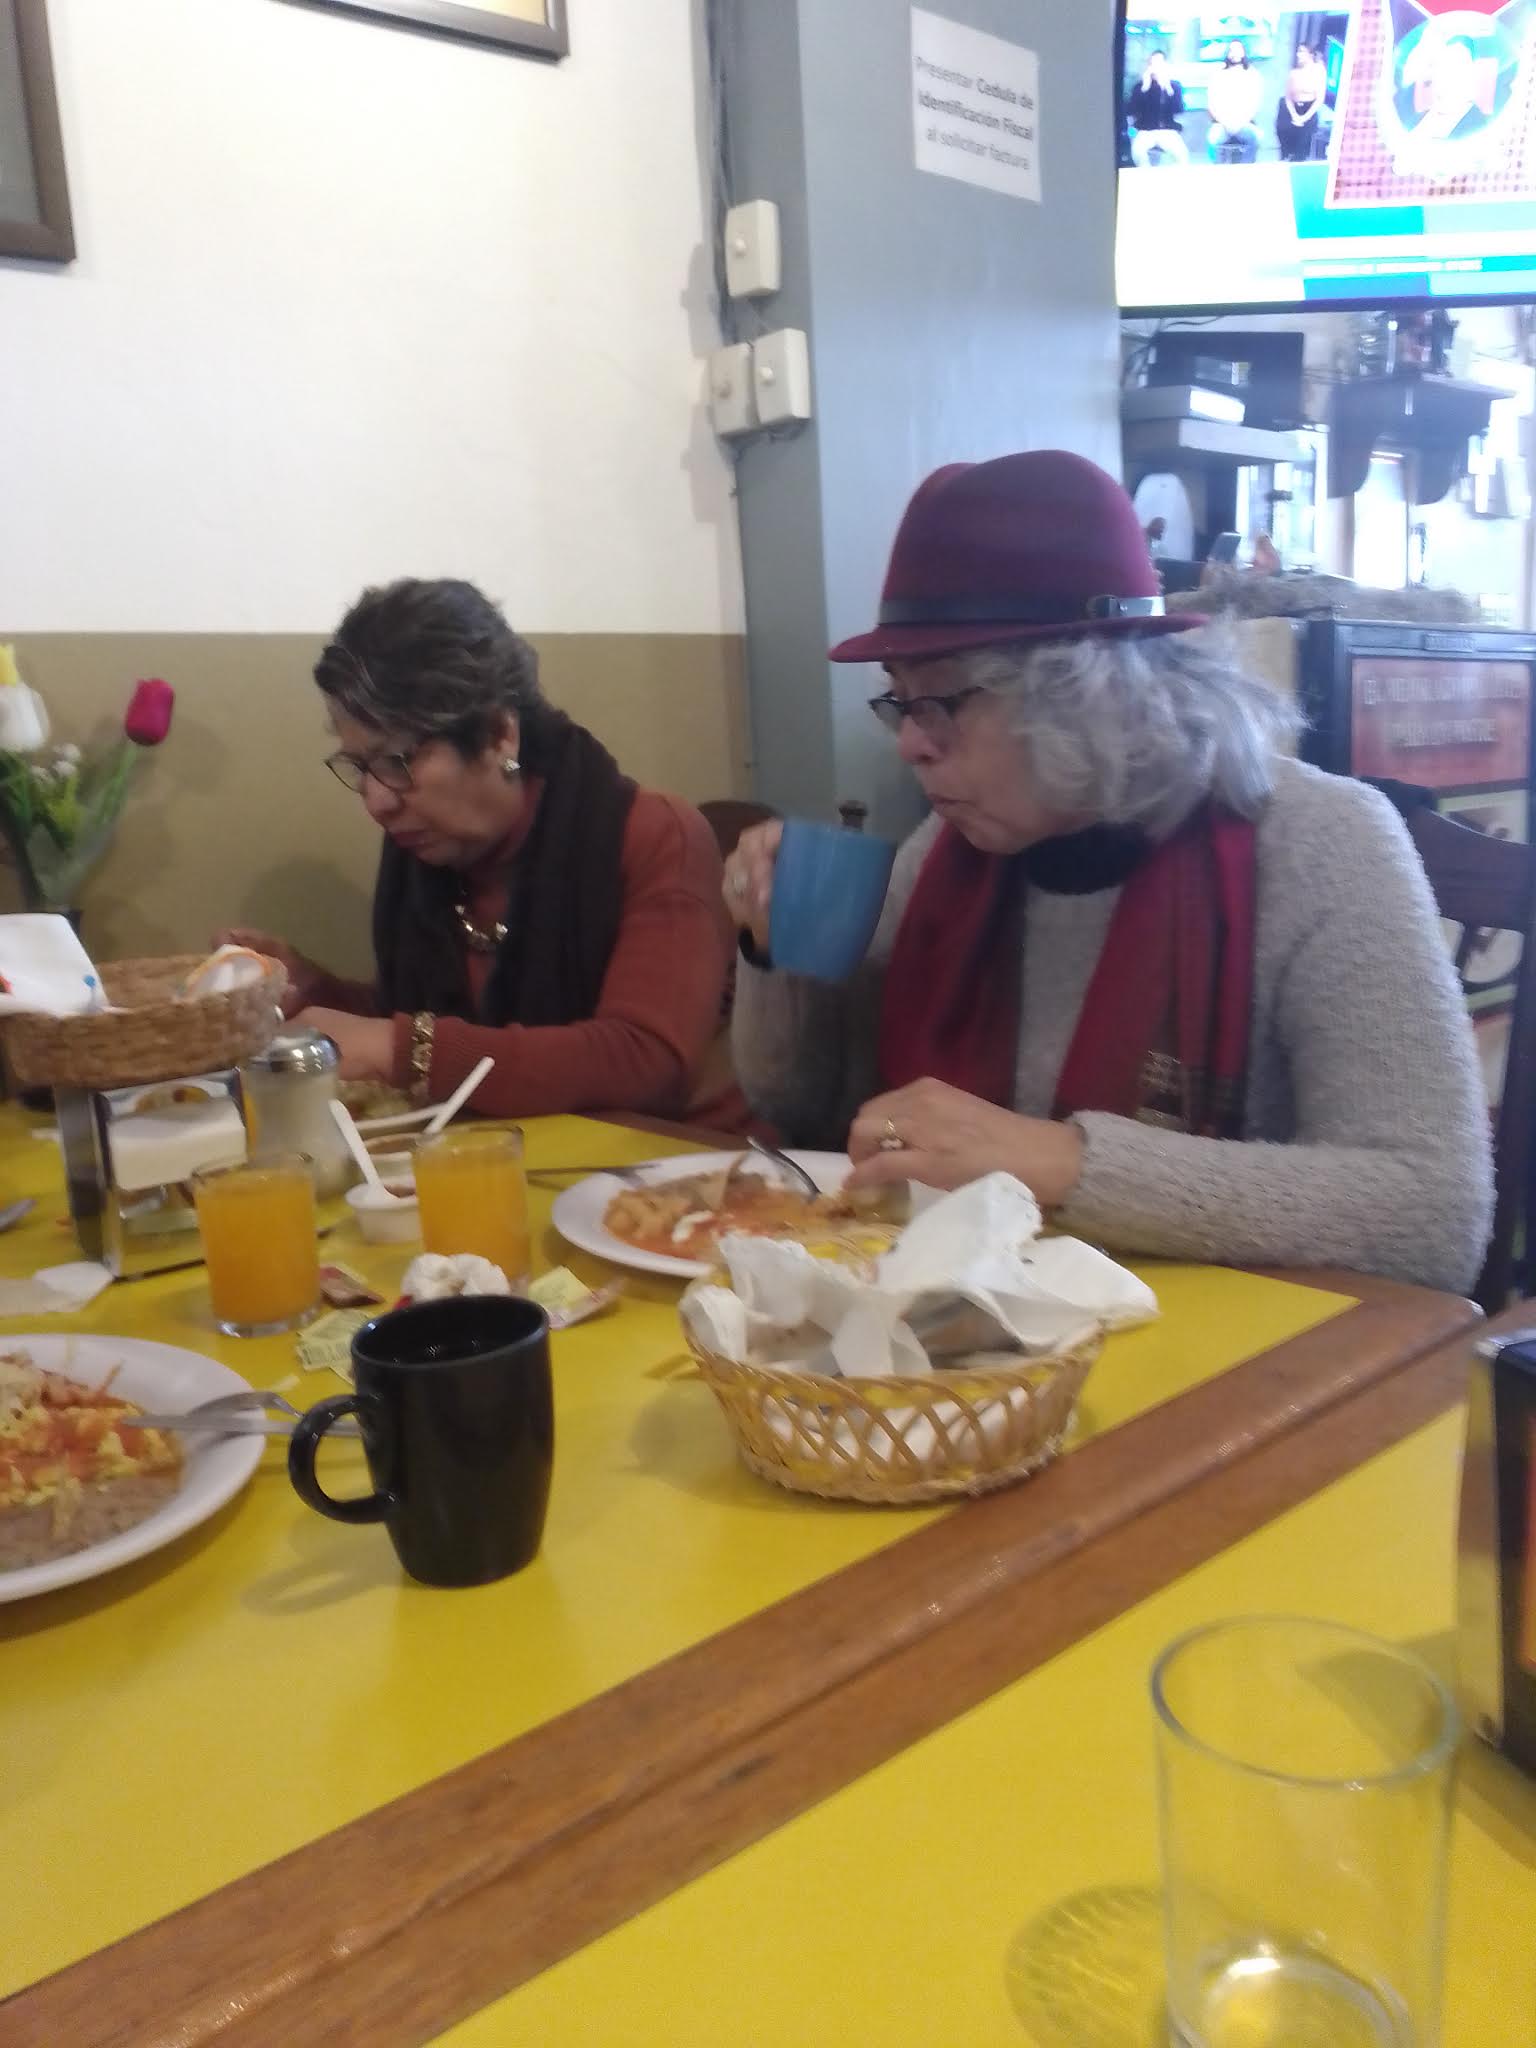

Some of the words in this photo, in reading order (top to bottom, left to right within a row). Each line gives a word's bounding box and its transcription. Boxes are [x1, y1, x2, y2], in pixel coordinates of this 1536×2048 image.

[912, 56, 972, 88] Presentar
[1019, 92, 1034, 110] de
[927, 126, 937, 141] al
[940, 131, 986, 156] solicitar
[989, 143, 1030, 169] factura
[1003, 117, 1033, 141] Fiscal
